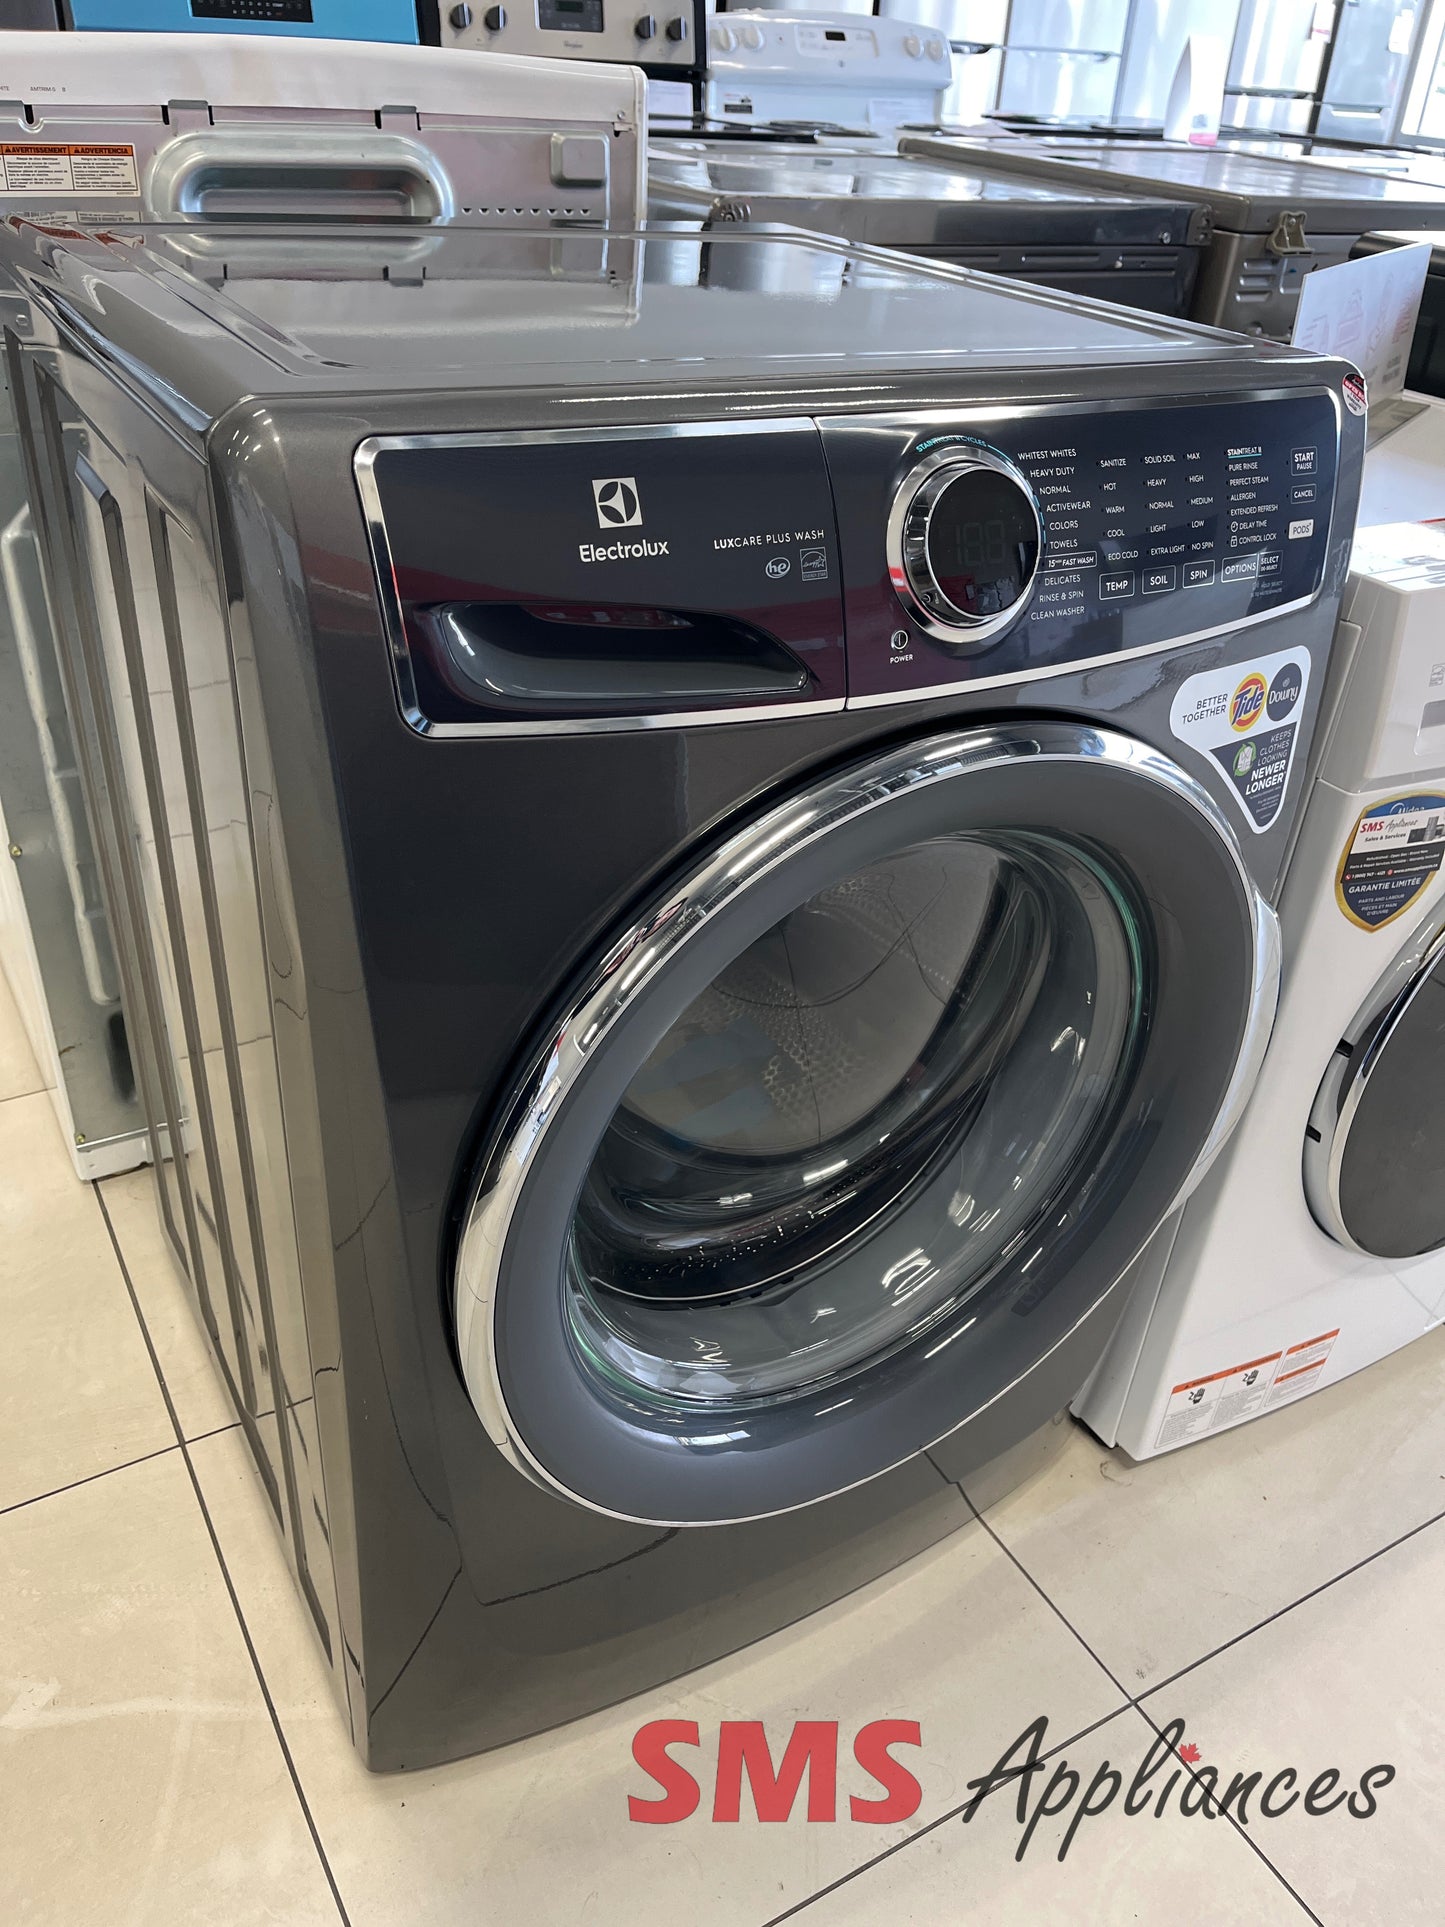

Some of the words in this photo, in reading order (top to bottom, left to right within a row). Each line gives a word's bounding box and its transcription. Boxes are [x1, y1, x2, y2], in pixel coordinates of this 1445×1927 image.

[961, 436, 987, 447] CYCLES
[1018, 451, 1048, 460] WHITEST
[1050, 448, 1076, 458] WHITES
[1228, 447, 1257, 456] STAINTREAT
[1294, 452, 1314, 462] START
[1100, 458, 1126, 467] SANITIZE
[1144, 456, 1162, 464] SOLID
[1297, 462, 1312, 470] PAUSE
[1030, 469, 1054, 478] HEAVY
[1056, 466, 1075, 476] DUTY
[1147, 479, 1166, 487] HEAVY
[1230, 478, 1251, 486] PERFECT
[1252, 476, 1269, 484] STEAM
[1040, 485, 1071, 495] NORMAL
[1103, 483, 1116, 491] HOT
[1230, 492, 1256, 501] ALLERGEN
[1294, 489, 1313, 498] CANCEL
[1046, 501, 1091, 512] ACTIVEWEAR
[1149, 501, 1174, 510] NORMAL
[1190, 497, 1214, 505] MEDIUM
[1231, 506, 1256, 516] EXTENDED
[1258, 504, 1278, 512] REFRESH
[1050, 520, 1079, 531] COLORS
[1150, 524, 1166, 533] LIGHT
[1192, 520, 1204, 529] LOW
[1240, 521, 1255, 530] DELAY
[1107, 529, 1125, 537] COOL
[1239, 535, 1262, 544] CONTROL
[1264, 533, 1277, 541] LOCK
[714, 535, 762, 550] LUXCARE
[766, 532, 791, 544] PLUS
[794, 529, 824, 541] WASH
[1050, 539, 1078, 549] TOWELS
[1202, 541, 1214, 549] SPIN
[579, 538, 669, 563] Electrolux
[1169, 545, 1185, 553] LIGHT
[1122, 551, 1139, 559] COLD
[1260, 556, 1279, 565] SELECT
[769, 561, 786, 574] he
[1062, 558, 1076, 566] FAST
[1225, 562, 1256, 575] OPTIONS
[1045, 575, 1080, 586] DELICATES
[1150, 575, 1168, 586] SOIL
[1190, 570, 1208, 580] SPIN
[1106, 580, 1128, 591] TEMP
[1040, 593, 1059, 603] RINSE
[1068, 591, 1084, 599] SPIN
[1031, 611, 1054, 620] CLEAN
[1056, 606, 1085, 616] WASHER
[890, 654, 913, 664] POWER
[1269, 685, 1299, 705] Downy
[1196, 694, 1228, 710] BETTER
[1231, 684, 1264, 726] Tide
[1182, 704, 1226, 725] TOGETHER
[1270, 729, 1291, 743] KEEPS
[1259, 740, 1290, 757] CLOTHES
[1258, 750, 1287, 767] LOOKING
[1251, 760, 1286, 781] NEWER
[1360, 821, 1384, 833] SMS
[1385, 818, 1418, 833] Appliances
[1349, 883, 1390, 893] GARANTIE
[1391, 877, 1421, 888] LIMITÉE
